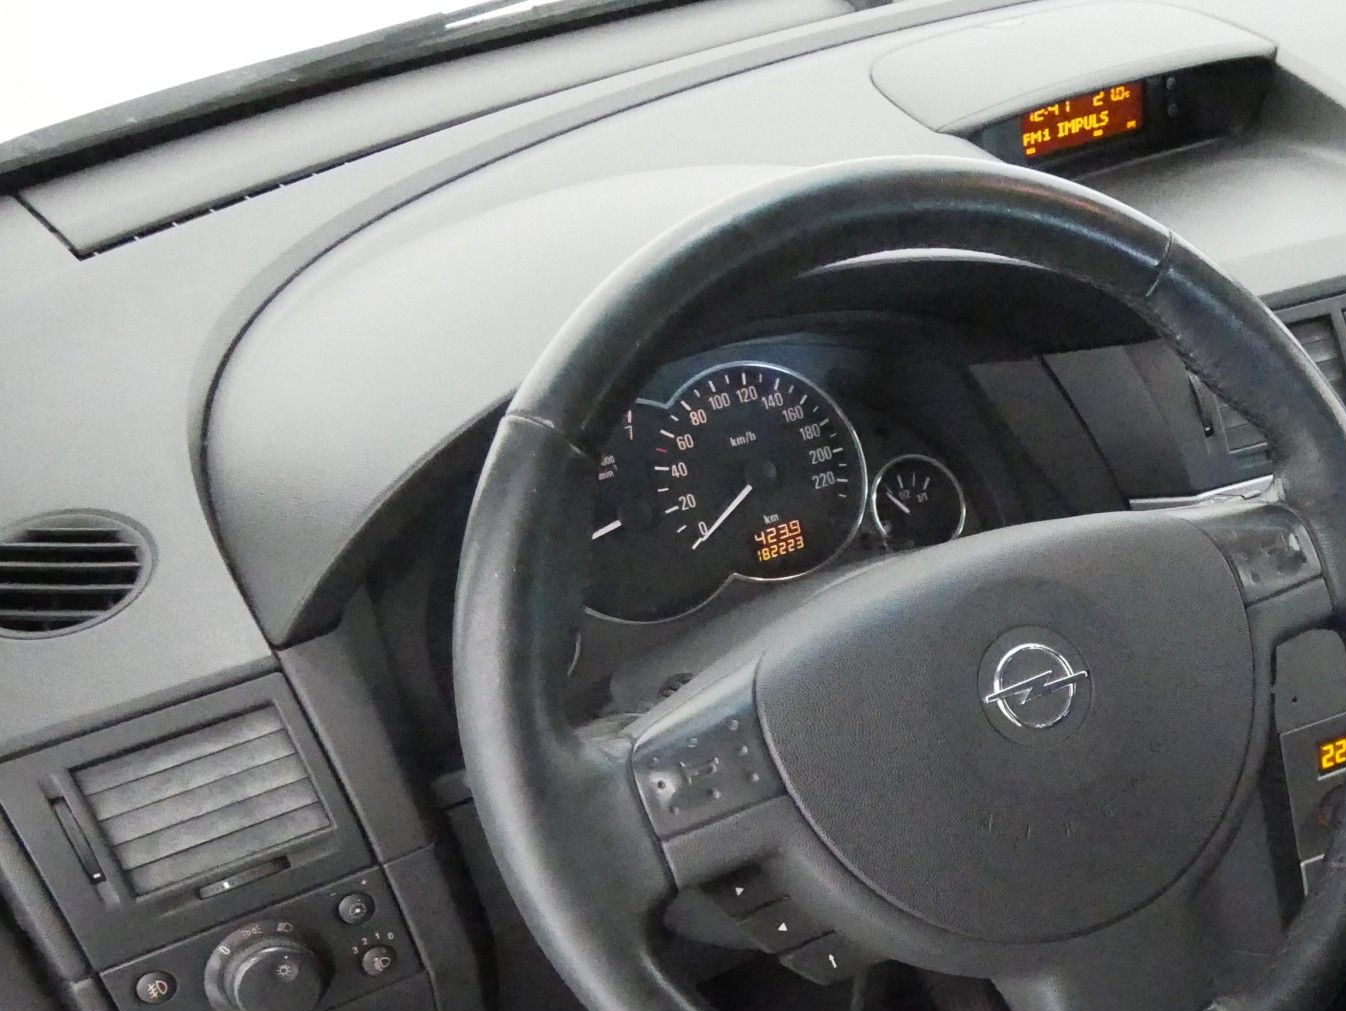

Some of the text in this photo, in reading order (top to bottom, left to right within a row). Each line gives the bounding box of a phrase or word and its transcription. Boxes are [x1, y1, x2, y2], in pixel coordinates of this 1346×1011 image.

[1022, 110, 1109, 147] FM1 IMPULS
[708, 392, 731, 410] 100
[736, 385, 758, 403] 120
[761, 392, 784, 410] 140
[689, 409, 708, 426] 80
[781, 405, 804, 423] 160
[624, 425, 634, 440] 7
[729, 431, 757, 448] km/h
[799, 423, 821, 441] 180
[676, 433, 694, 451] 60
[808, 446, 833, 465] 200
[671, 462, 688, 478] 40
[812, 471, 836, 490] 220
[678, 493, 697, 511] 20
[763, 513, 780, 525] km
[698, 521, 708, 537] 0
[756, 536, 805, 562] 182223
